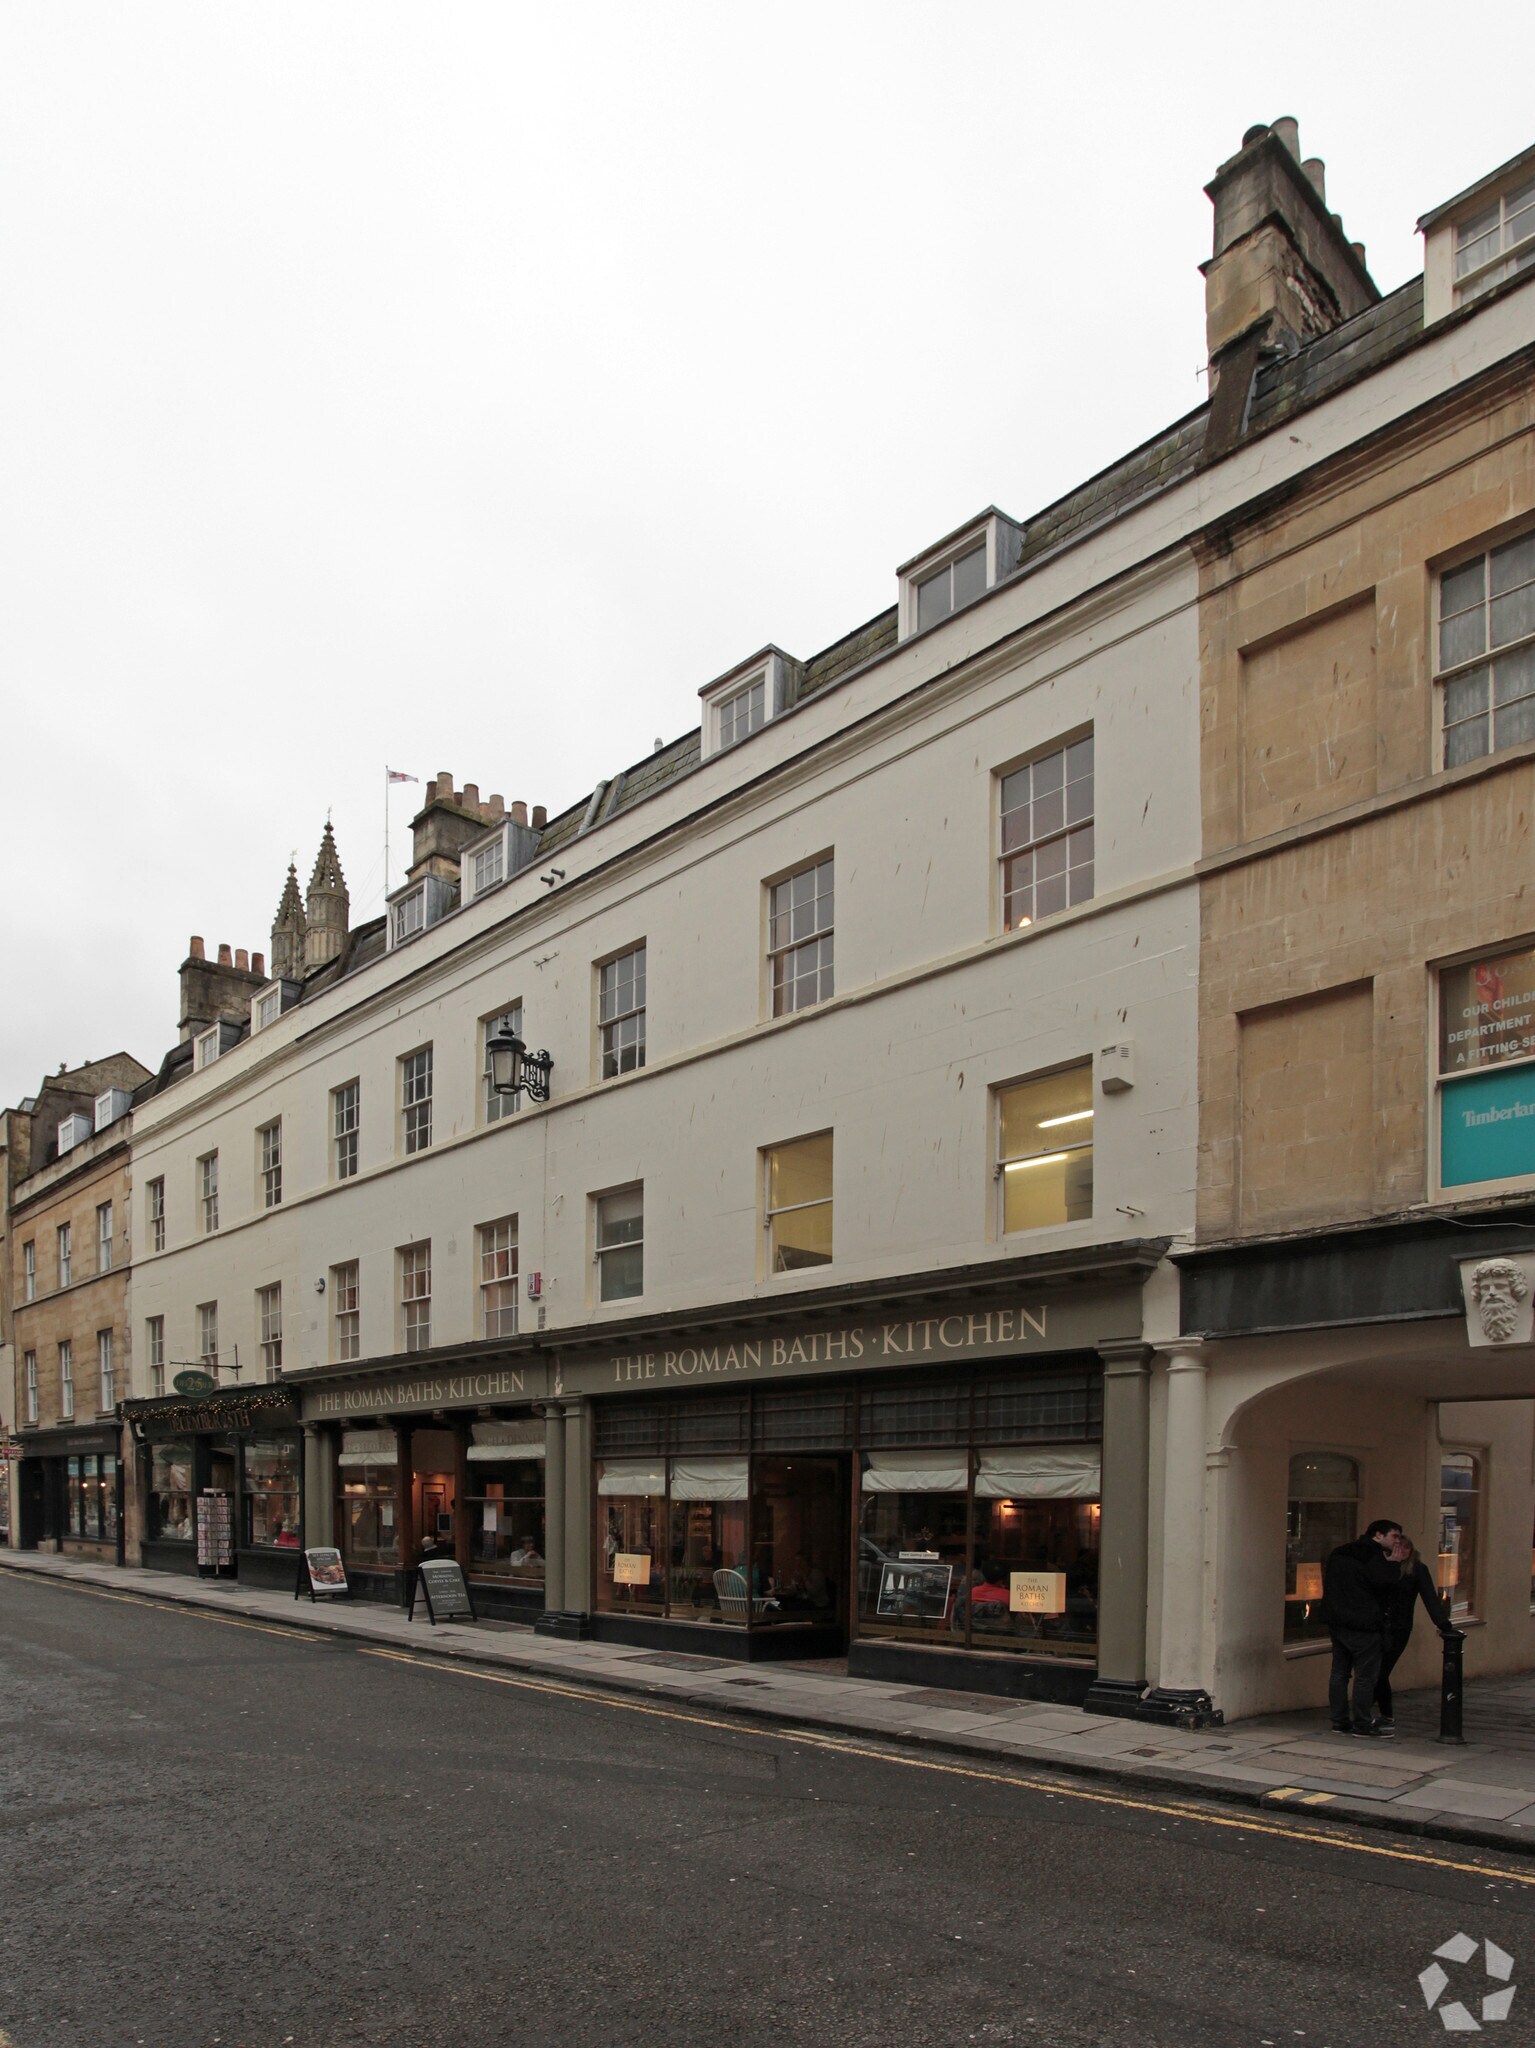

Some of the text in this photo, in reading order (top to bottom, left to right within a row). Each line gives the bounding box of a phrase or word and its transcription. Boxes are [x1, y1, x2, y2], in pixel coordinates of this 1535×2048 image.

[1462, 1003, 1489, 1018] OUR
[1448, 1014, 1532, 1044] DEPARTMENT
[1456, 1052, 1465, 1063] A
[1468, 1039, 1519, 1061] FITTING
[611, 1305, 1048, 1382] THE ROMAN BATHS KITCHEN
[317, 1369, 525, 1412] THE ROMAN BATHS KITCHEN
[1016, 1584, 1049, 1592] ROMAN
[1019, 1592, 1046, 1601] BATHS
